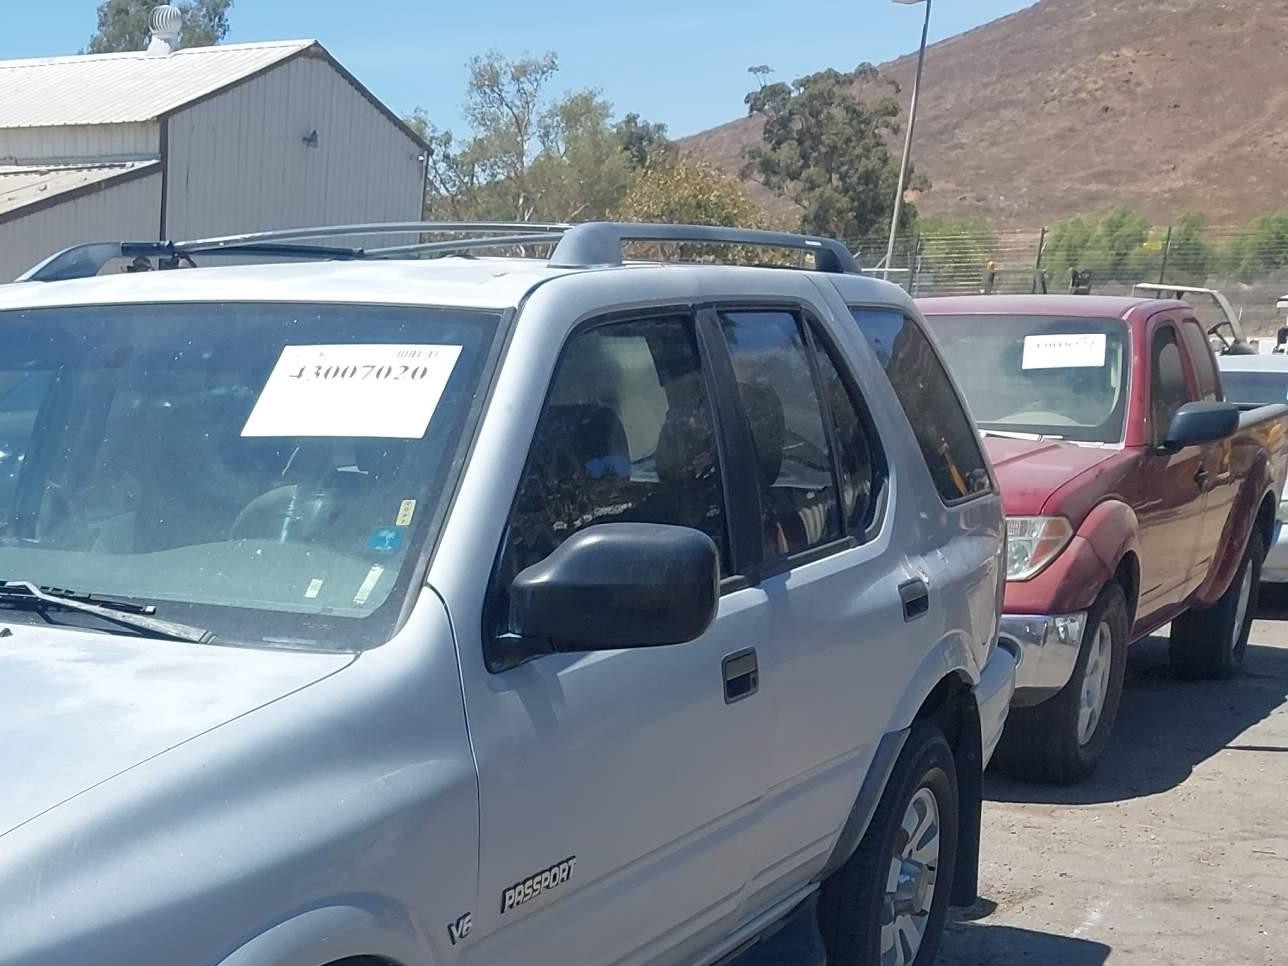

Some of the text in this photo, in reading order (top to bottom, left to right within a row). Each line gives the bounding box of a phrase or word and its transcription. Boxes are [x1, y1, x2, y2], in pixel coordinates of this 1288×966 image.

[289, 364, 430, 381] 43007020
[500, 855, 577, 915] PASSPORT
[447, 911, 473, 946] V6
